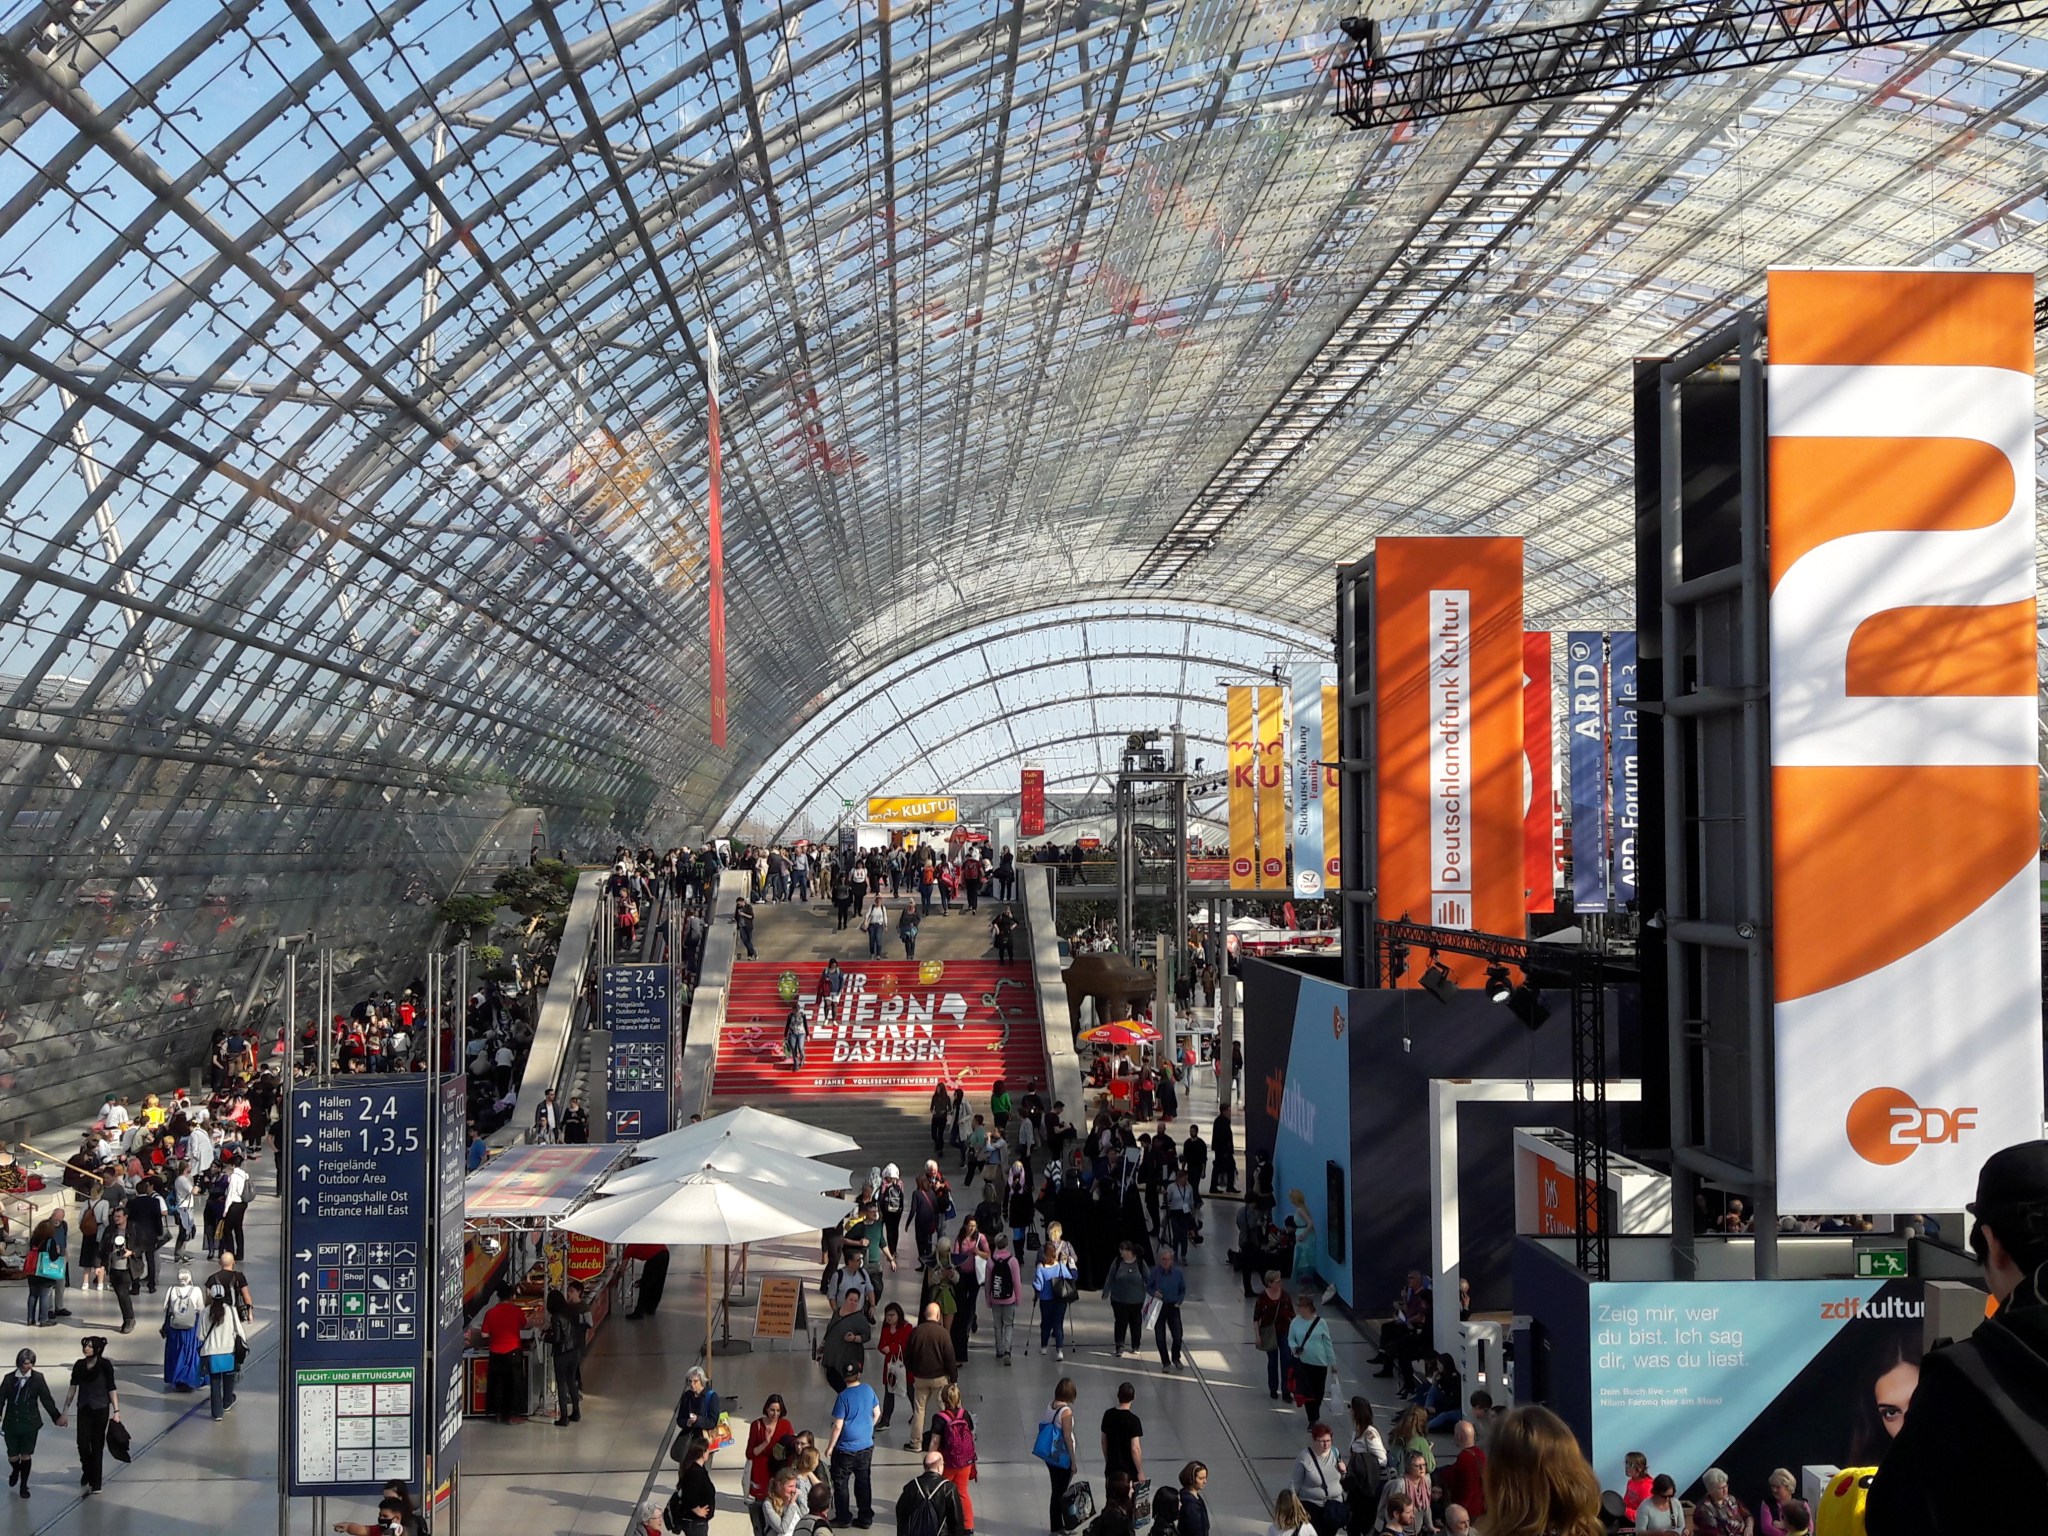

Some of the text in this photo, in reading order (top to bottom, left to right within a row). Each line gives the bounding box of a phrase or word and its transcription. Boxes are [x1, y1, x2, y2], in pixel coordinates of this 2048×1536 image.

[1574, 664, 1601, 741] ARD
[1619, 683, 1637, 739] Hale
[1440, 598, 1460, 883] Deutschlandfunk Kultur
[1298, 726, 1310, 835] Süddeutsche Zeitung
[1310, 760, 1319, 799] Familie
[869, 799, 956, 820] mdr KULTUR
[1302, 874, 1316, 883] SZ
[636, 970, 655, 984] 2,4
[636, 986, 666, 1000] 1,3,5
[833, 1039, 945, 1062] DAS LESEN
[319, 1096, 398, 1124] Hallen 2,4
[319, 1110, 344, 1121] Halls
[319, 1127, 418, 1155] Hallen 1,3,5
[319, 1141, 344, 1152] Halls
[318, 1159, 377, 1173] Freigelände
[318, 1173, 386, 1184] Outdoor Area
[318, 1191, 408, 1205] Eingangshalle Ost
[318, 1205, 408, 1216] Entrance Hall East
[320, 1246, 338, 1254] EXIT
[568, 1258, 602, 1269] andeln
[344, 1273, 364, 1281] Shop
[1598, 1304, 1719, 1325] Zeig mir, wer
[1598, 1328, 1743, 1348] du bist. Ich sag
[1599, 1351, 1749, 1370] dir, was du liest.
[352, 1372, 412, 1380] RETTUNGSPLAN
